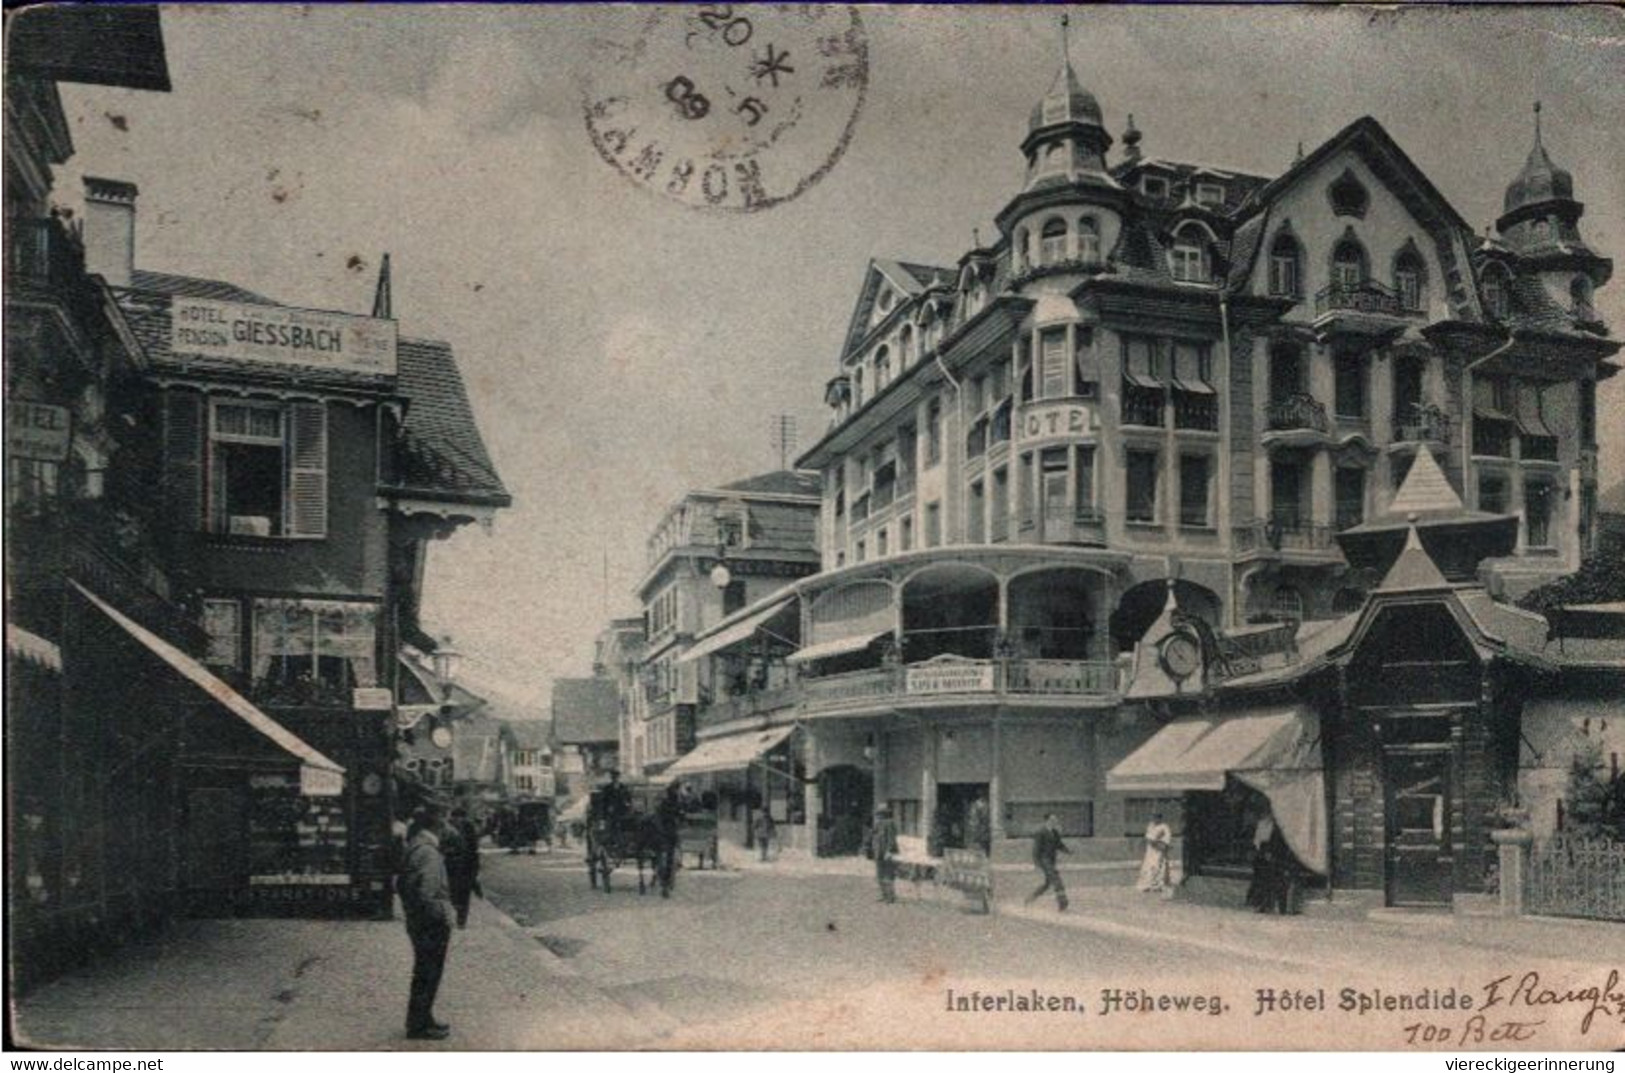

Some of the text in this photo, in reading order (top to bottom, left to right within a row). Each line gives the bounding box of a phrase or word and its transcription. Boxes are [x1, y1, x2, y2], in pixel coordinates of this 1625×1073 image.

[180, 304, 228, 325] HOTEL
[177, 326, 229, 347] PENSION
[232, 319, 342, 353] GIESSBACH
[1098, 988, 1231, 1016] Höheweg.
[1254, 987, 1325, 1016] Hôtel
[1339, 987, 1474, 1015] Splendide
